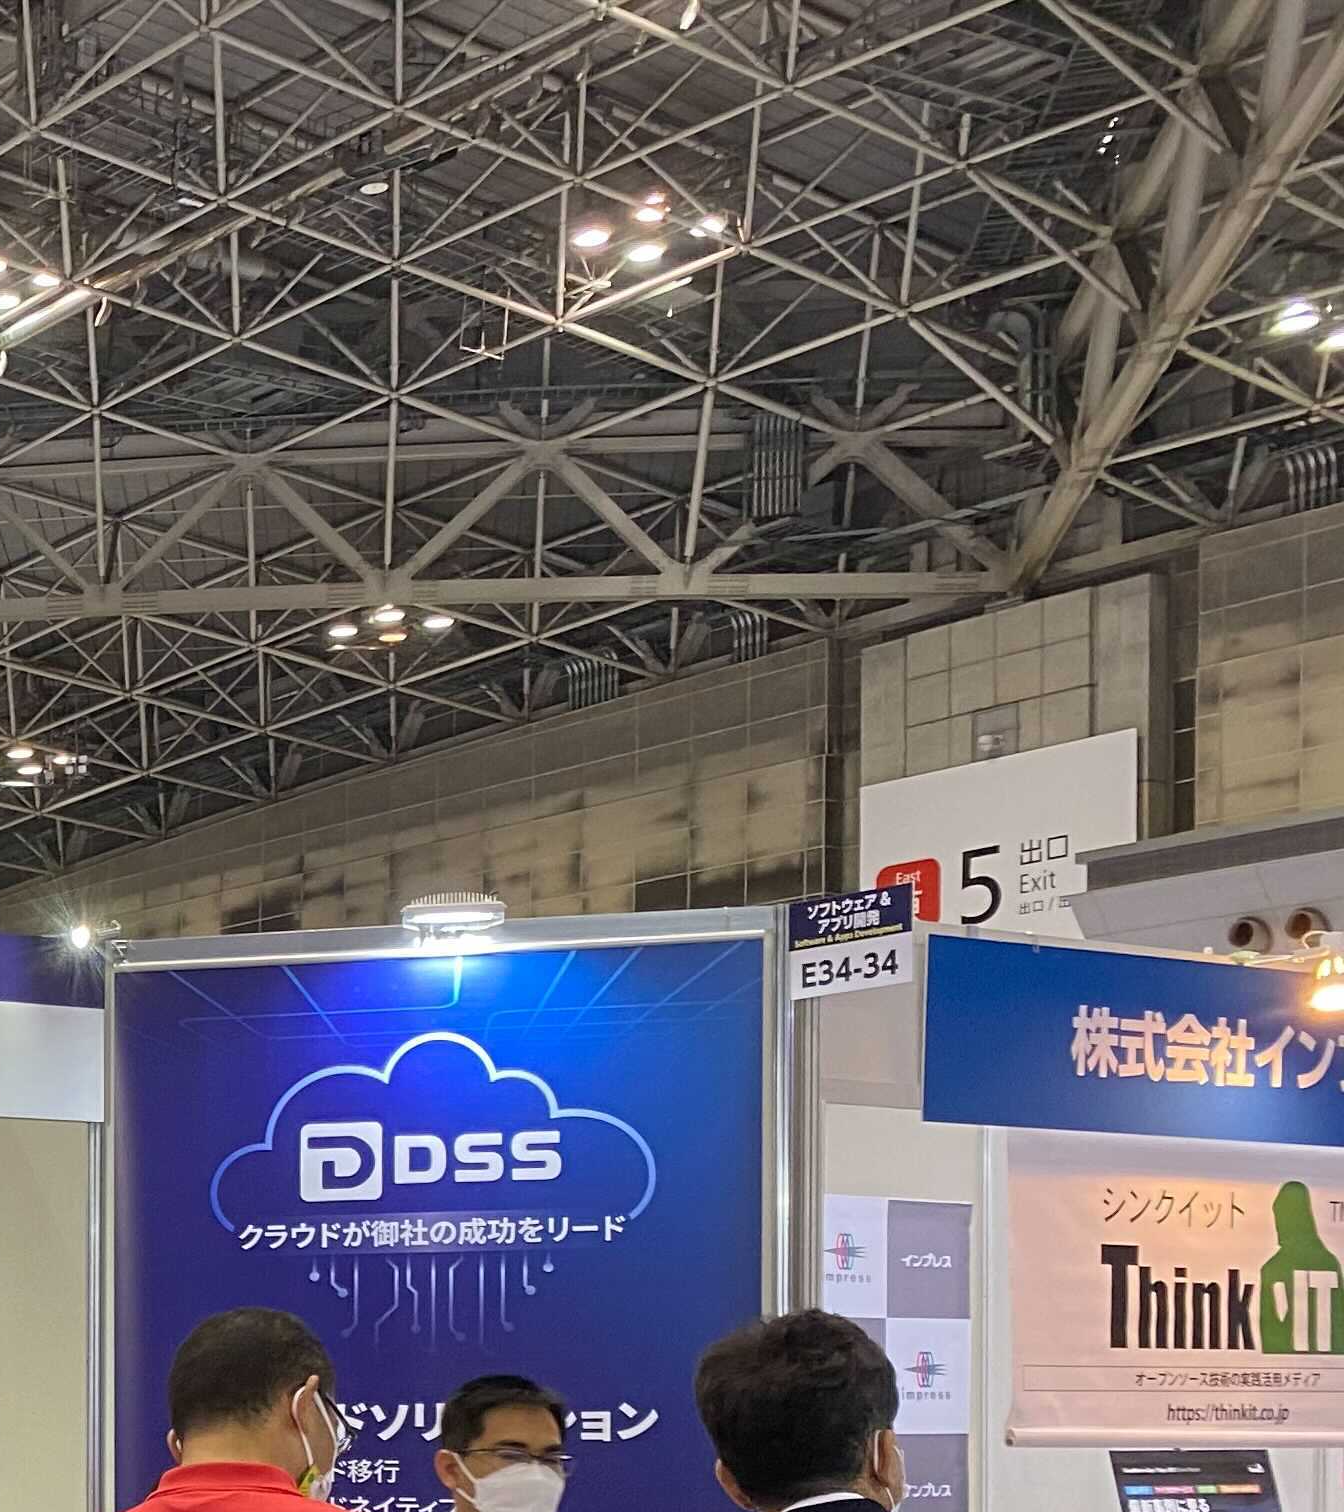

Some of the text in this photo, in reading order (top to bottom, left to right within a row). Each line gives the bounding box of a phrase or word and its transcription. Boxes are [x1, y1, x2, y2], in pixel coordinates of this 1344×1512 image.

[1019, 835, 1069, 866] 出口
[960, 845, 1002, 925] 5
[1019, 869, 1057, 894] Exit
[807, 891, 878, 920] ソフトウェア
[801, 950, 898, 989] E34-34
[393, 1129, 563, 1186] DSS
[1102, 1187, 1246, 1230] シンクイット
[237, 1215, 626, 1252] クラウドが御社の成功をリード
[825, 1271, 872, 1284] mpress
[1101, 1244, 1257, 1350] Think
